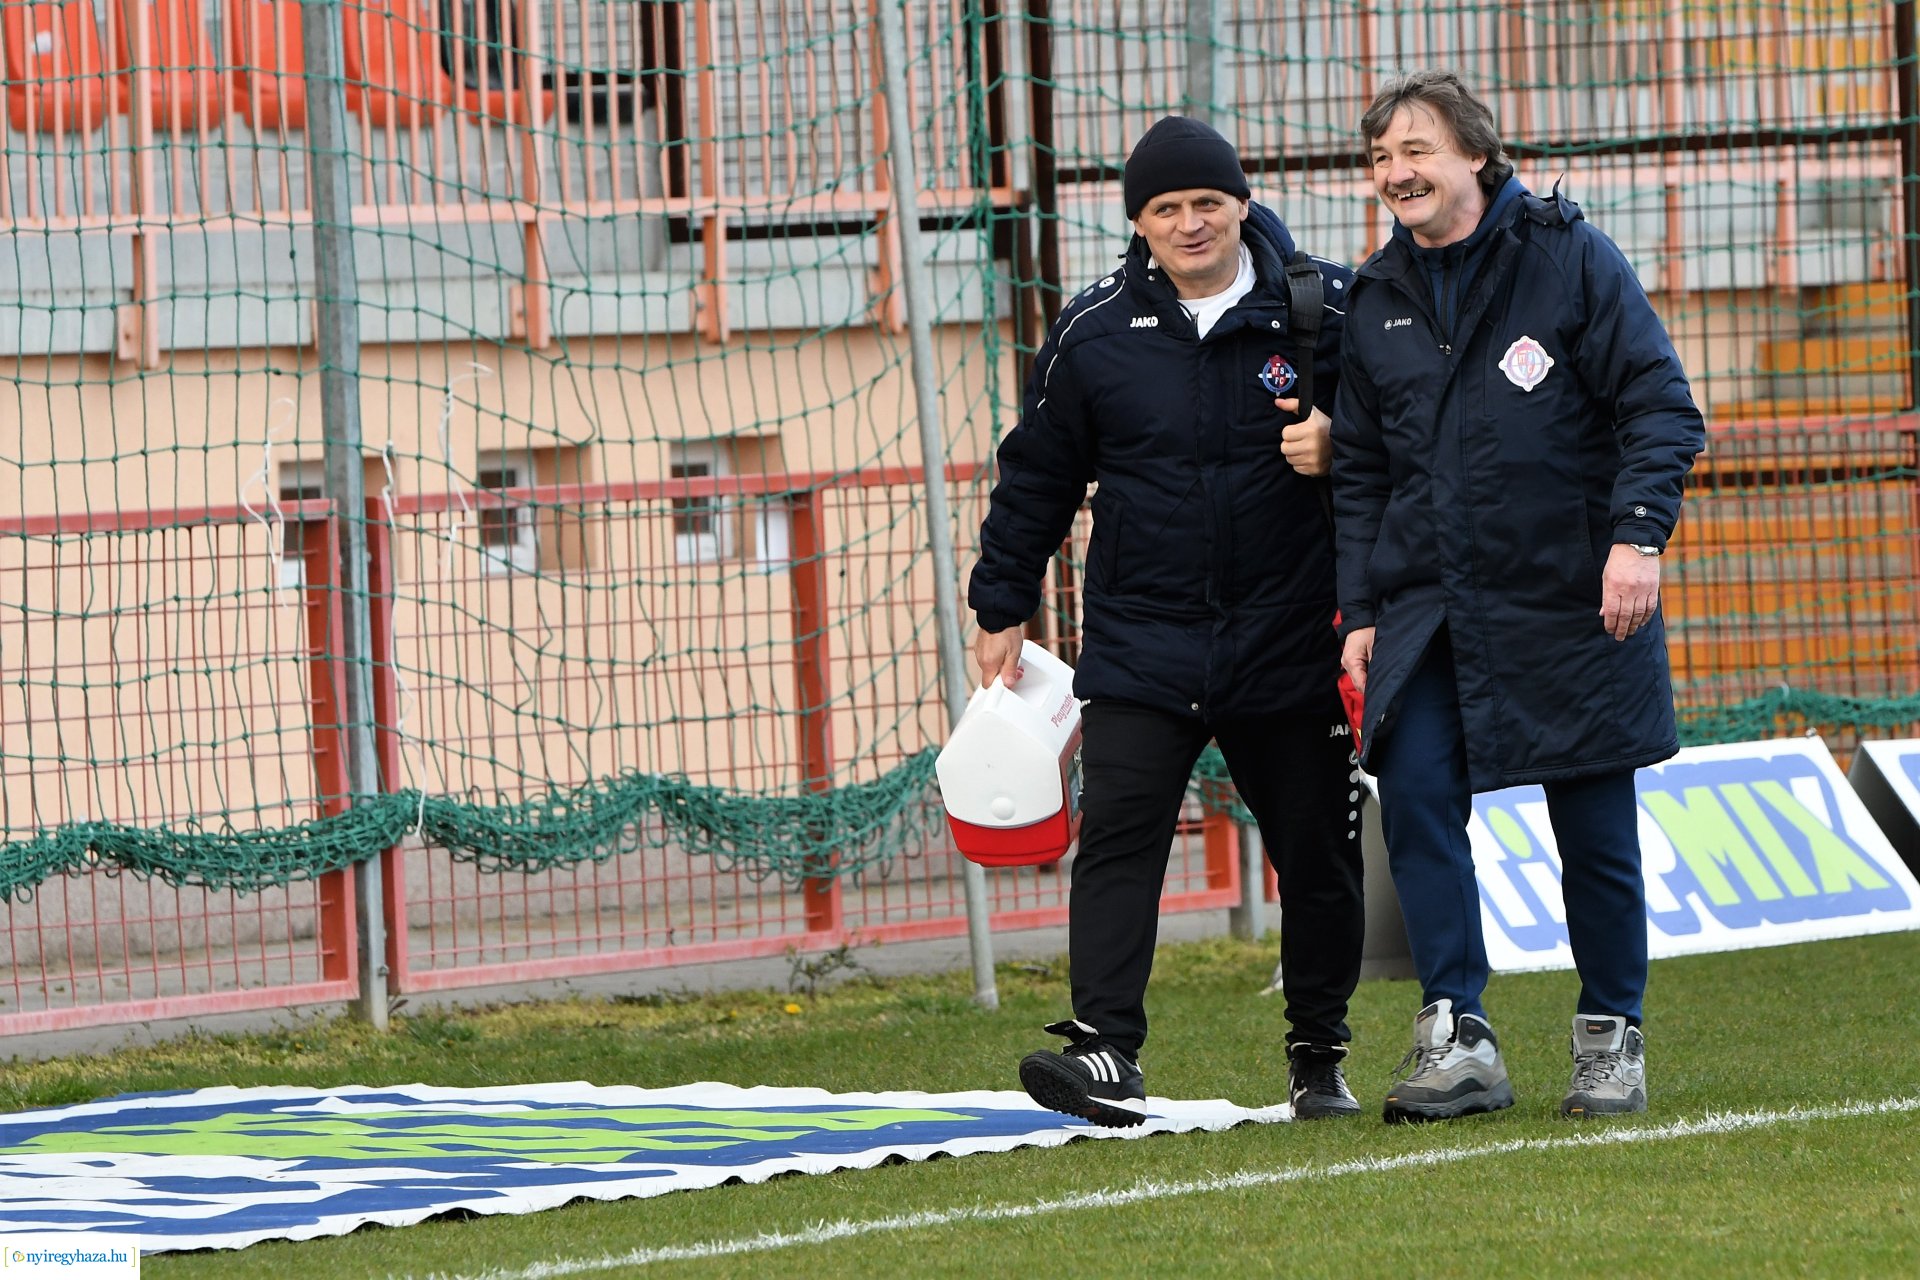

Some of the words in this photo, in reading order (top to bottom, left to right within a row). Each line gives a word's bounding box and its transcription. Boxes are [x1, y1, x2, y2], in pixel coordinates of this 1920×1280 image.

[1130, 316, 1159, 328] JAKO
[1393, 318, 1412, 327] JAKO
[1051, 693, 1074, 728] Playmate
